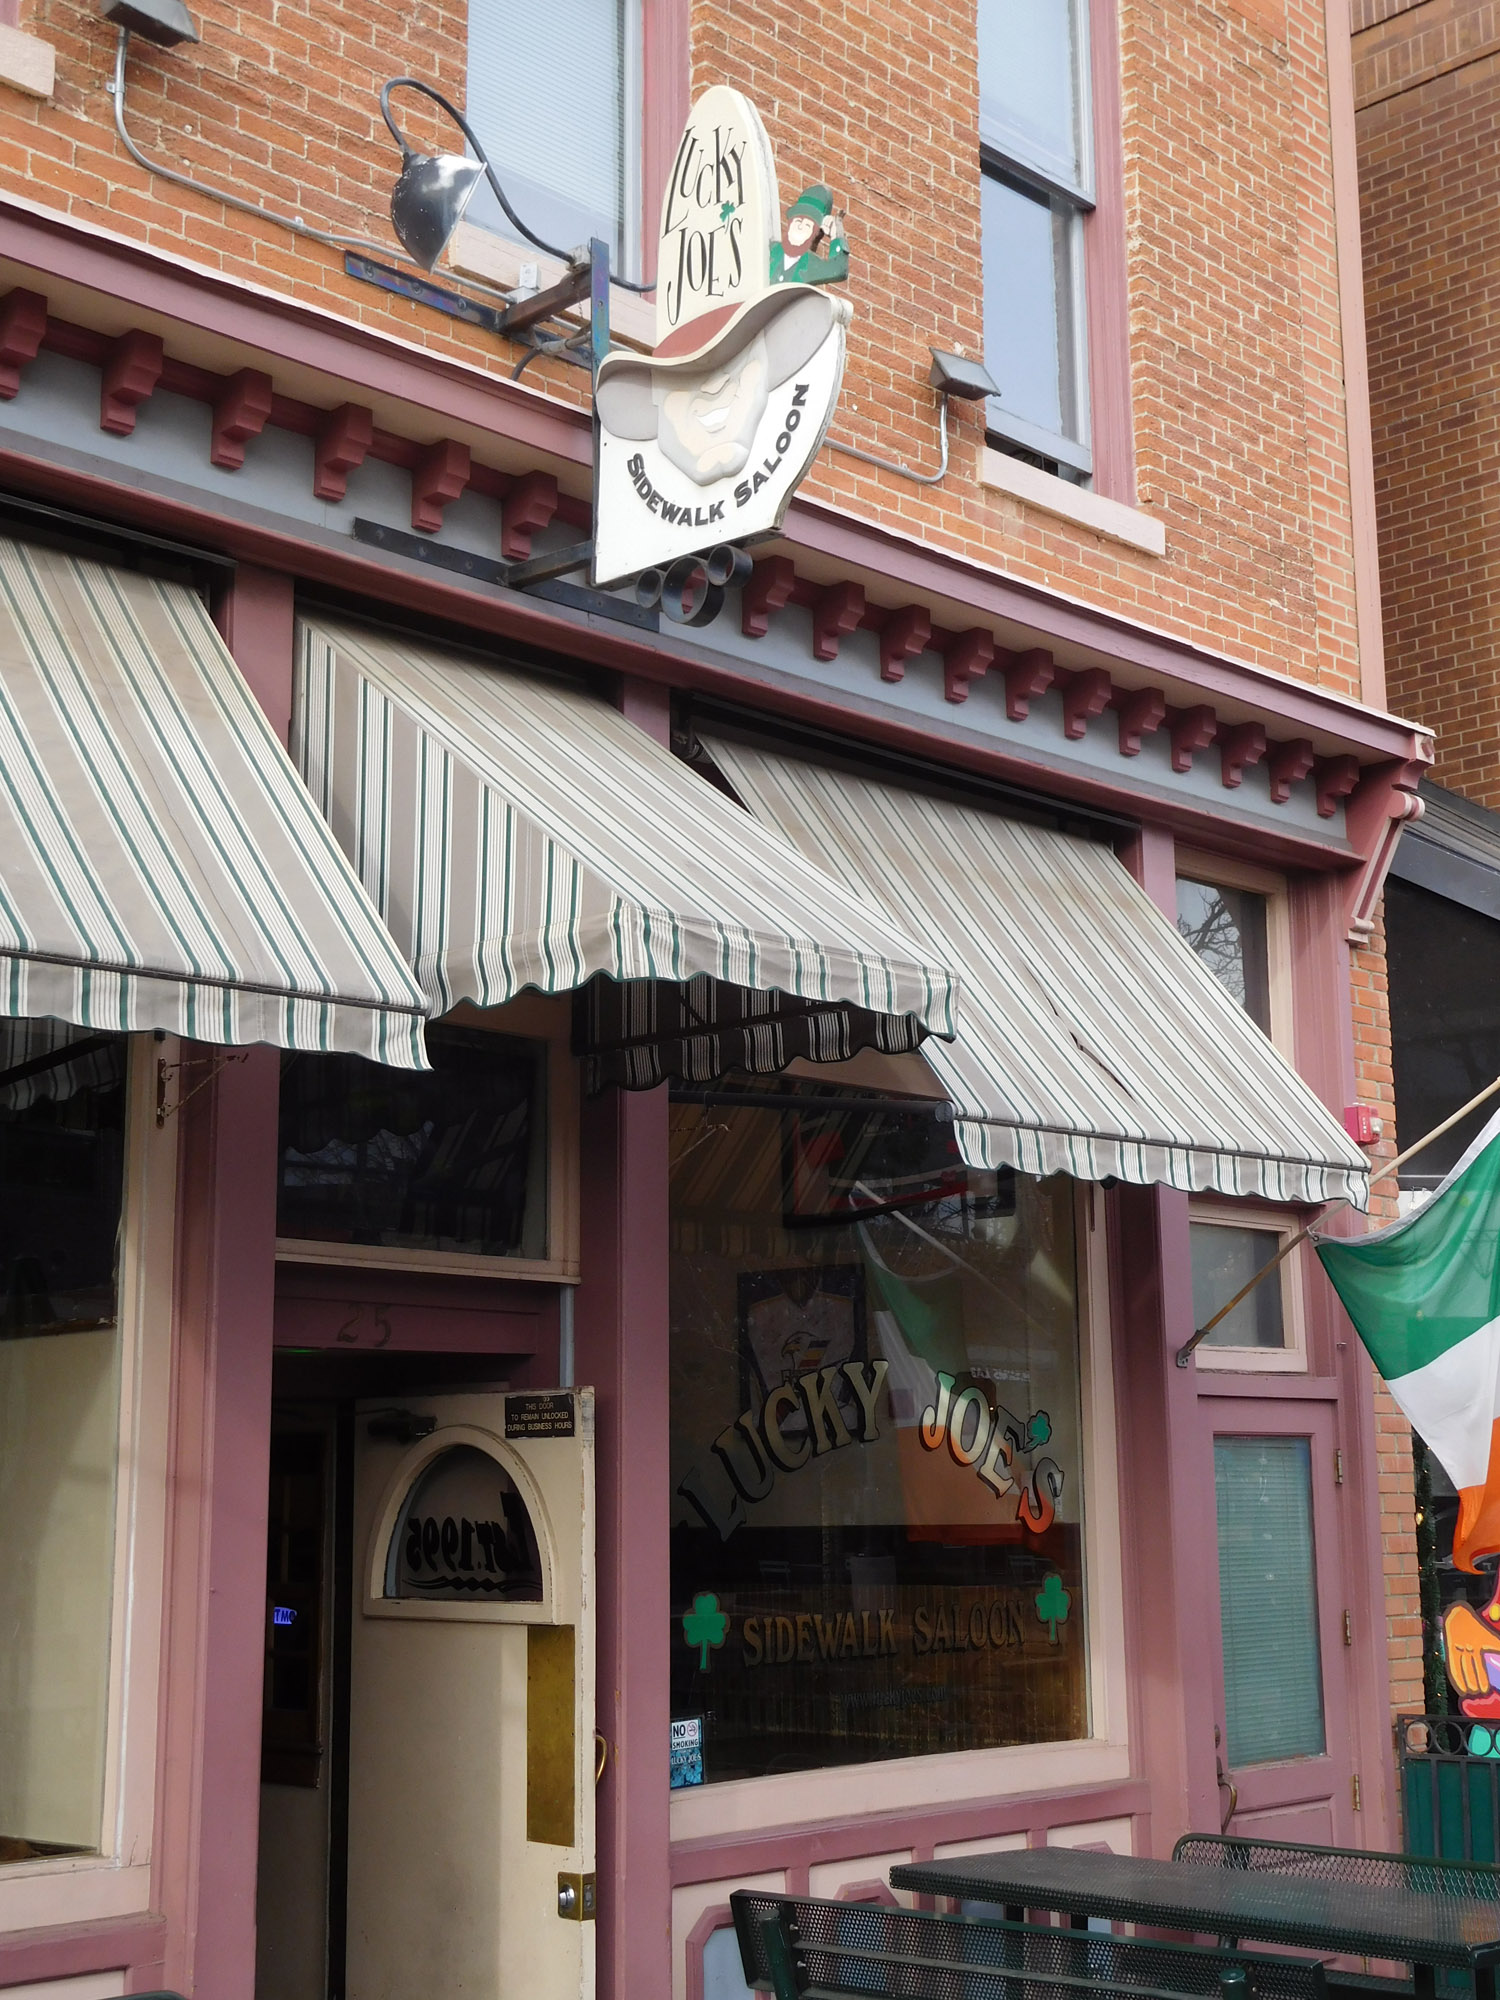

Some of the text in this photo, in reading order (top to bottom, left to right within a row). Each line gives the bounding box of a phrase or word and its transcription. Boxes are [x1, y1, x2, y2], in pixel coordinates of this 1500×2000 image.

[662, 124, 748, 239] LUCKY
[626, 382, 810, 528] SIDEWALK SALOON
[336, 1303, 393, 1348] 25
[507, 1421, 573, 1432] DURING BUSINESS HOURS
[510, 1411, 569, 1421] TO REMAIN UNLOCKED
[677, 1359, 889, 1543] LUCKY
[743, 1600, 1027, 1668] SIDEWALK SALOON
[672, 1739, 698, 1749] SMOKING
[673, 1724, 686, 1736] NO
